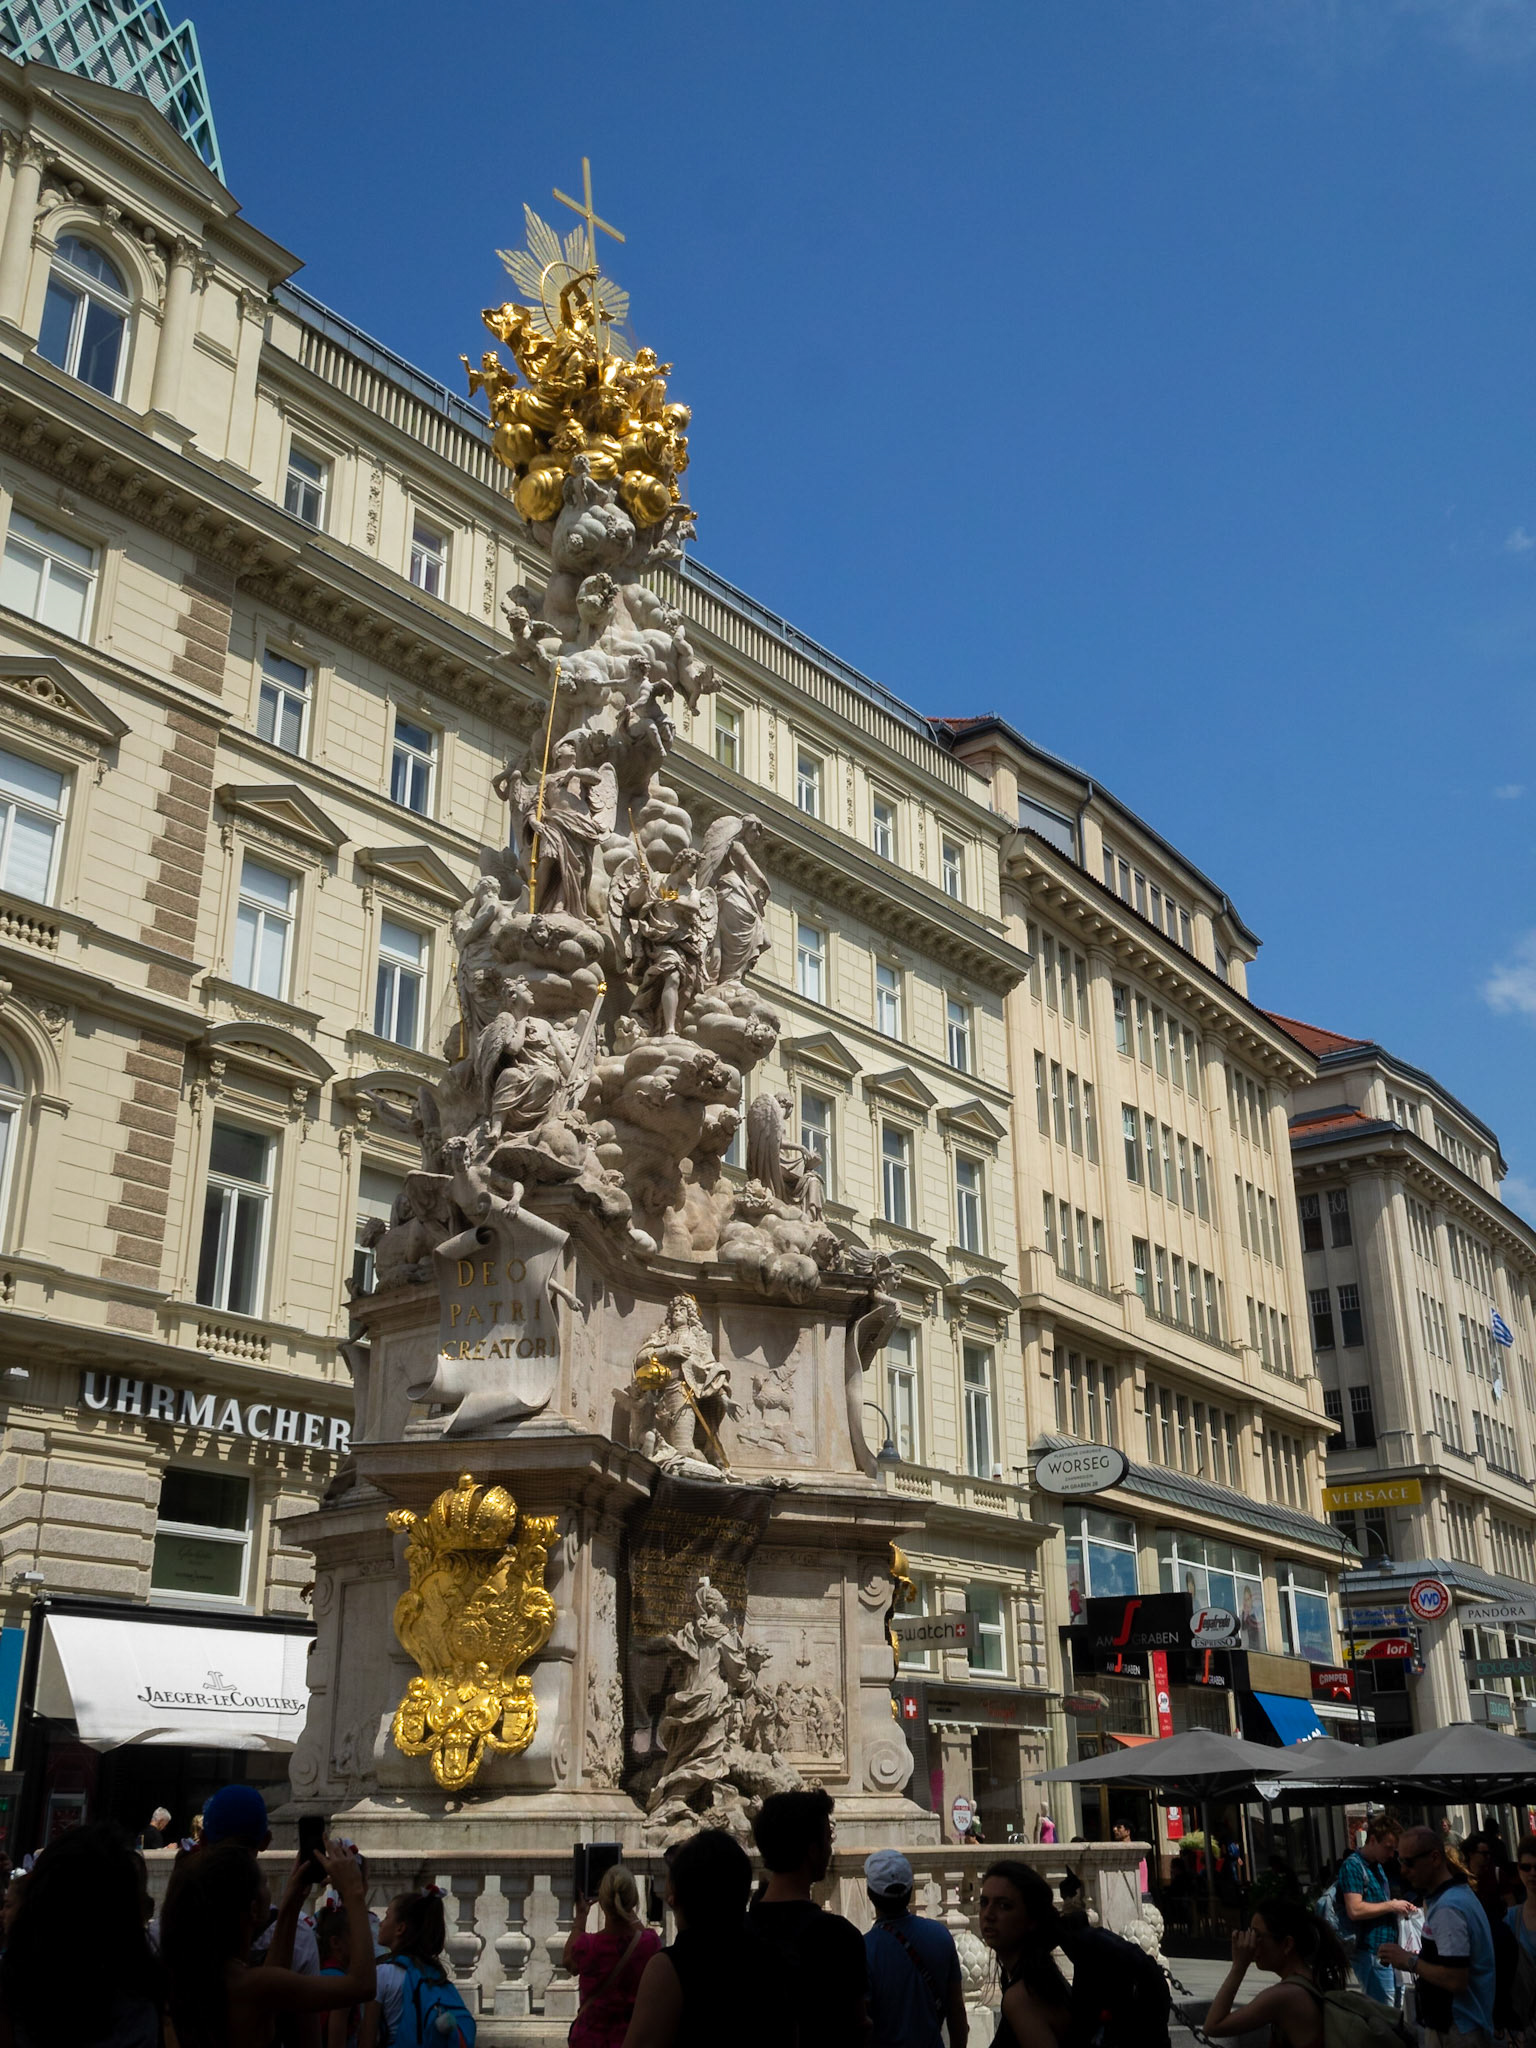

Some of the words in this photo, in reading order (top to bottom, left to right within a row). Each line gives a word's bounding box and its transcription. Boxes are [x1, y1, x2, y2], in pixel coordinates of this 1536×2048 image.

[457, 1260, 527, 1287] DEO
[450, 1299, 541, 1328] PATRI
[441, 1337, 556, 1361] CREATORI
[83, 1371, 352, 1456] UHRMACHER
[1048, 1456, 1110, 1475] WORSEG
[1070, 1482, 1092, 1490] GRABEN
[1332, 1487, 1409, 1504] VERSACE
[1420, 1592, 1440, 1607] VVD
[897, 1623, 955, 1641] swatch
[1095, 1634, 1114, 1647] AM
[1131, 1631, 1179, 1646] GRABEN
[1194, 1638, 1233, 1648] ESPRESSO
[1106, 1662, 1114, 1672] AM
[1122, 1664, 1141, 1676] GRABEN
[1476, 1661, 1533, 1676] DOUGLAS
[1208, 1674, 1225, 1686] GRABEN
